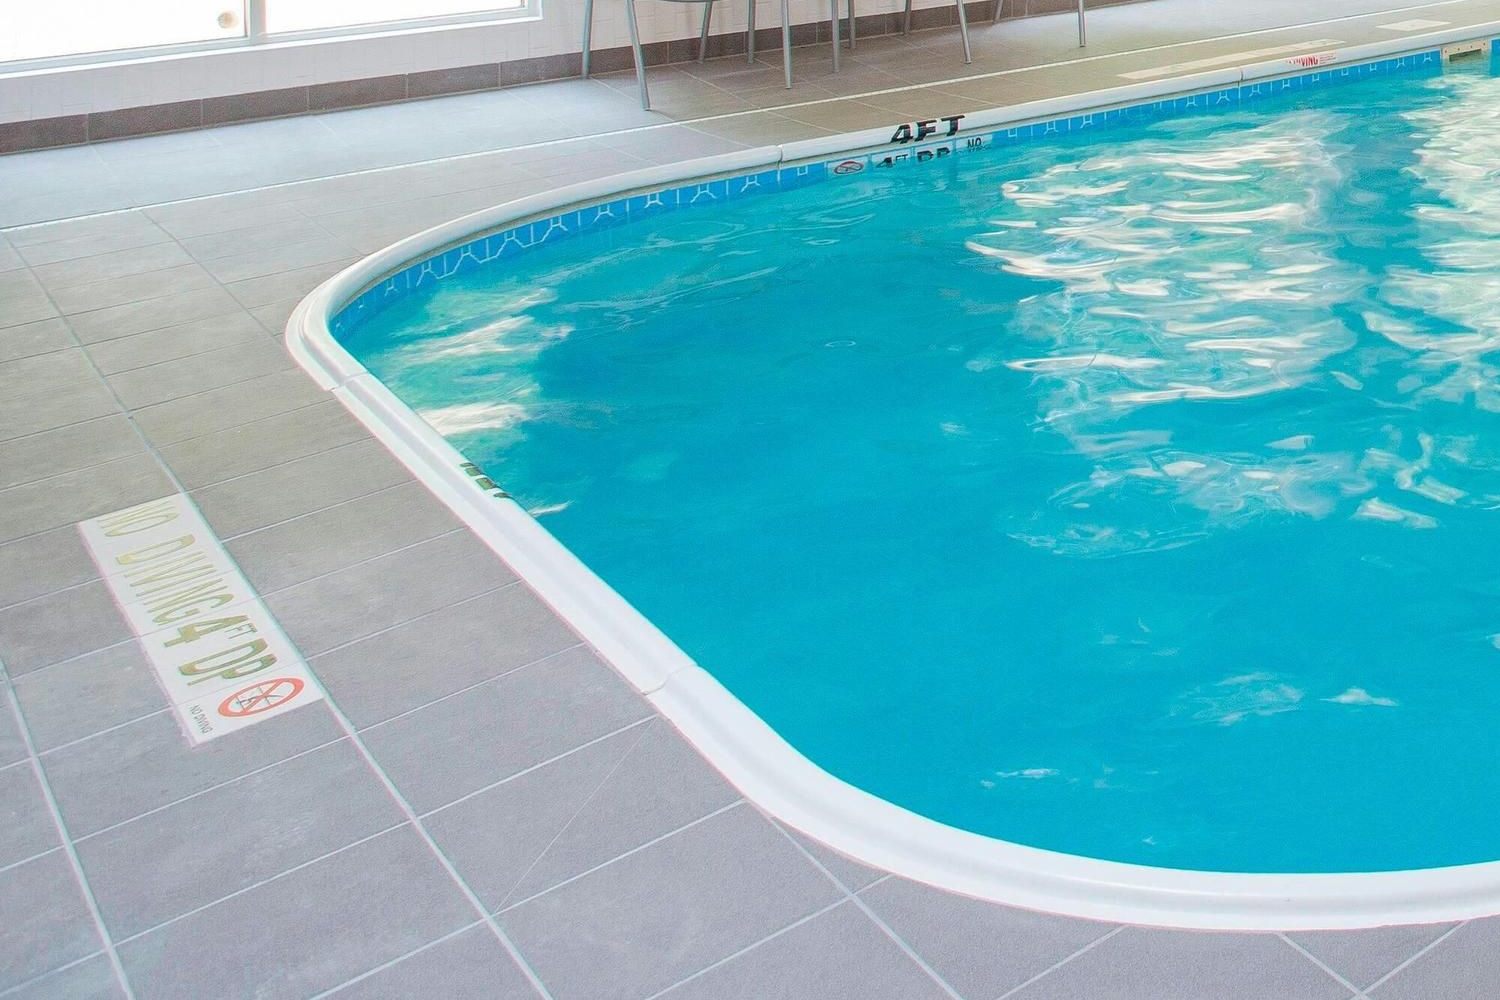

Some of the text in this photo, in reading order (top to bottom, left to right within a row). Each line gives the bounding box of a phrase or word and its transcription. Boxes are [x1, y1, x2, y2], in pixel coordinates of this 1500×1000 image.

[890, 114, 966, 144] 4FT
[967, 137, 982, 148] NO
[97, 501, 180, 537] NO
[115, 534, 234, 626] DIVING
[178, 638, 277, 686] DP
